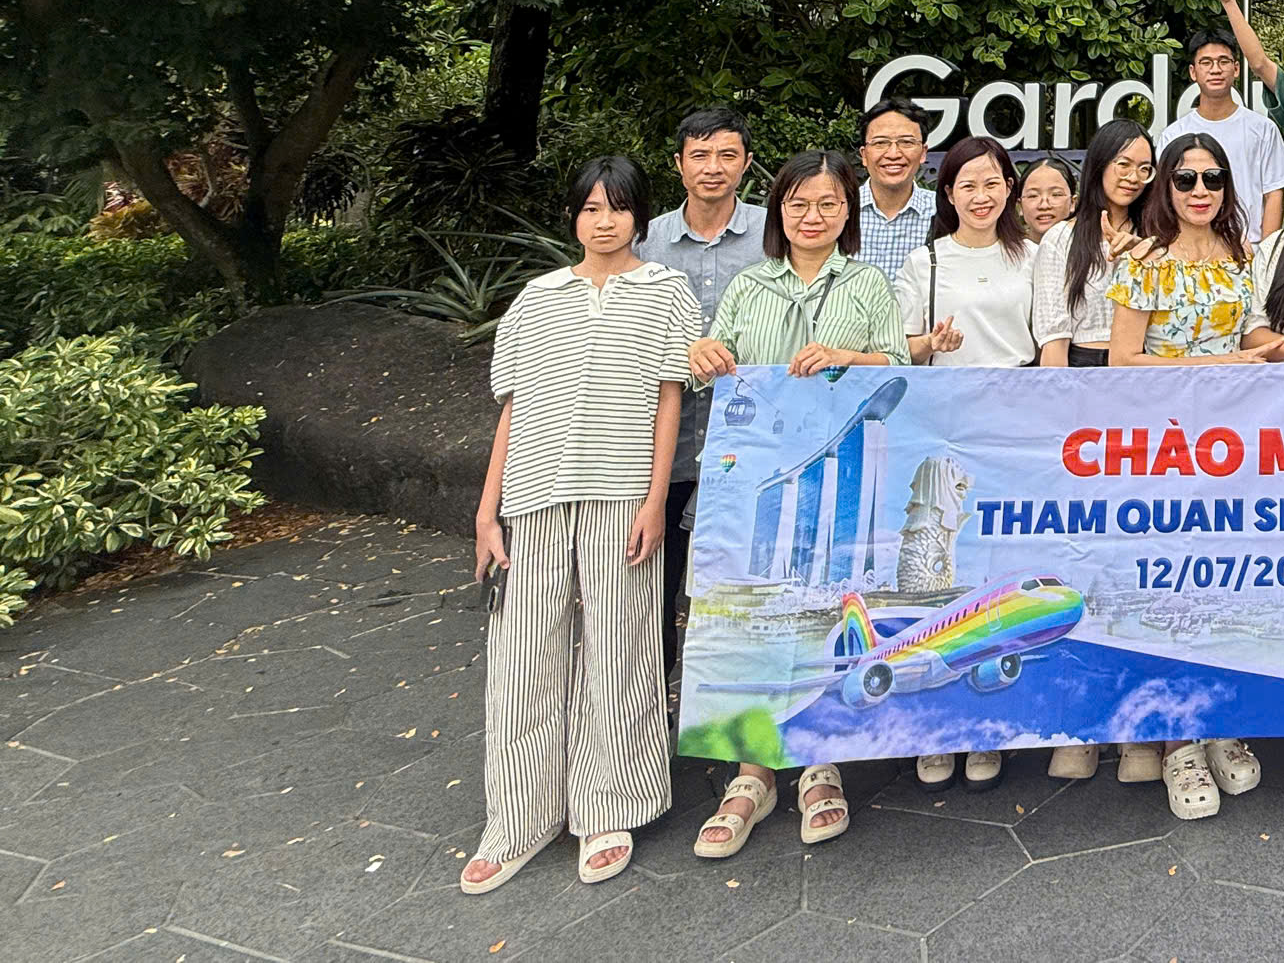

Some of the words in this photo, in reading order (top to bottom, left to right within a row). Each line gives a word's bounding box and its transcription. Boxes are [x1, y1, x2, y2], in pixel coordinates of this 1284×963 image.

[1062, 418, 1245, 477] CHÀO
[976, 499, 1108, 535] THAM
[1116, 498, 1244, 535] QUAN
